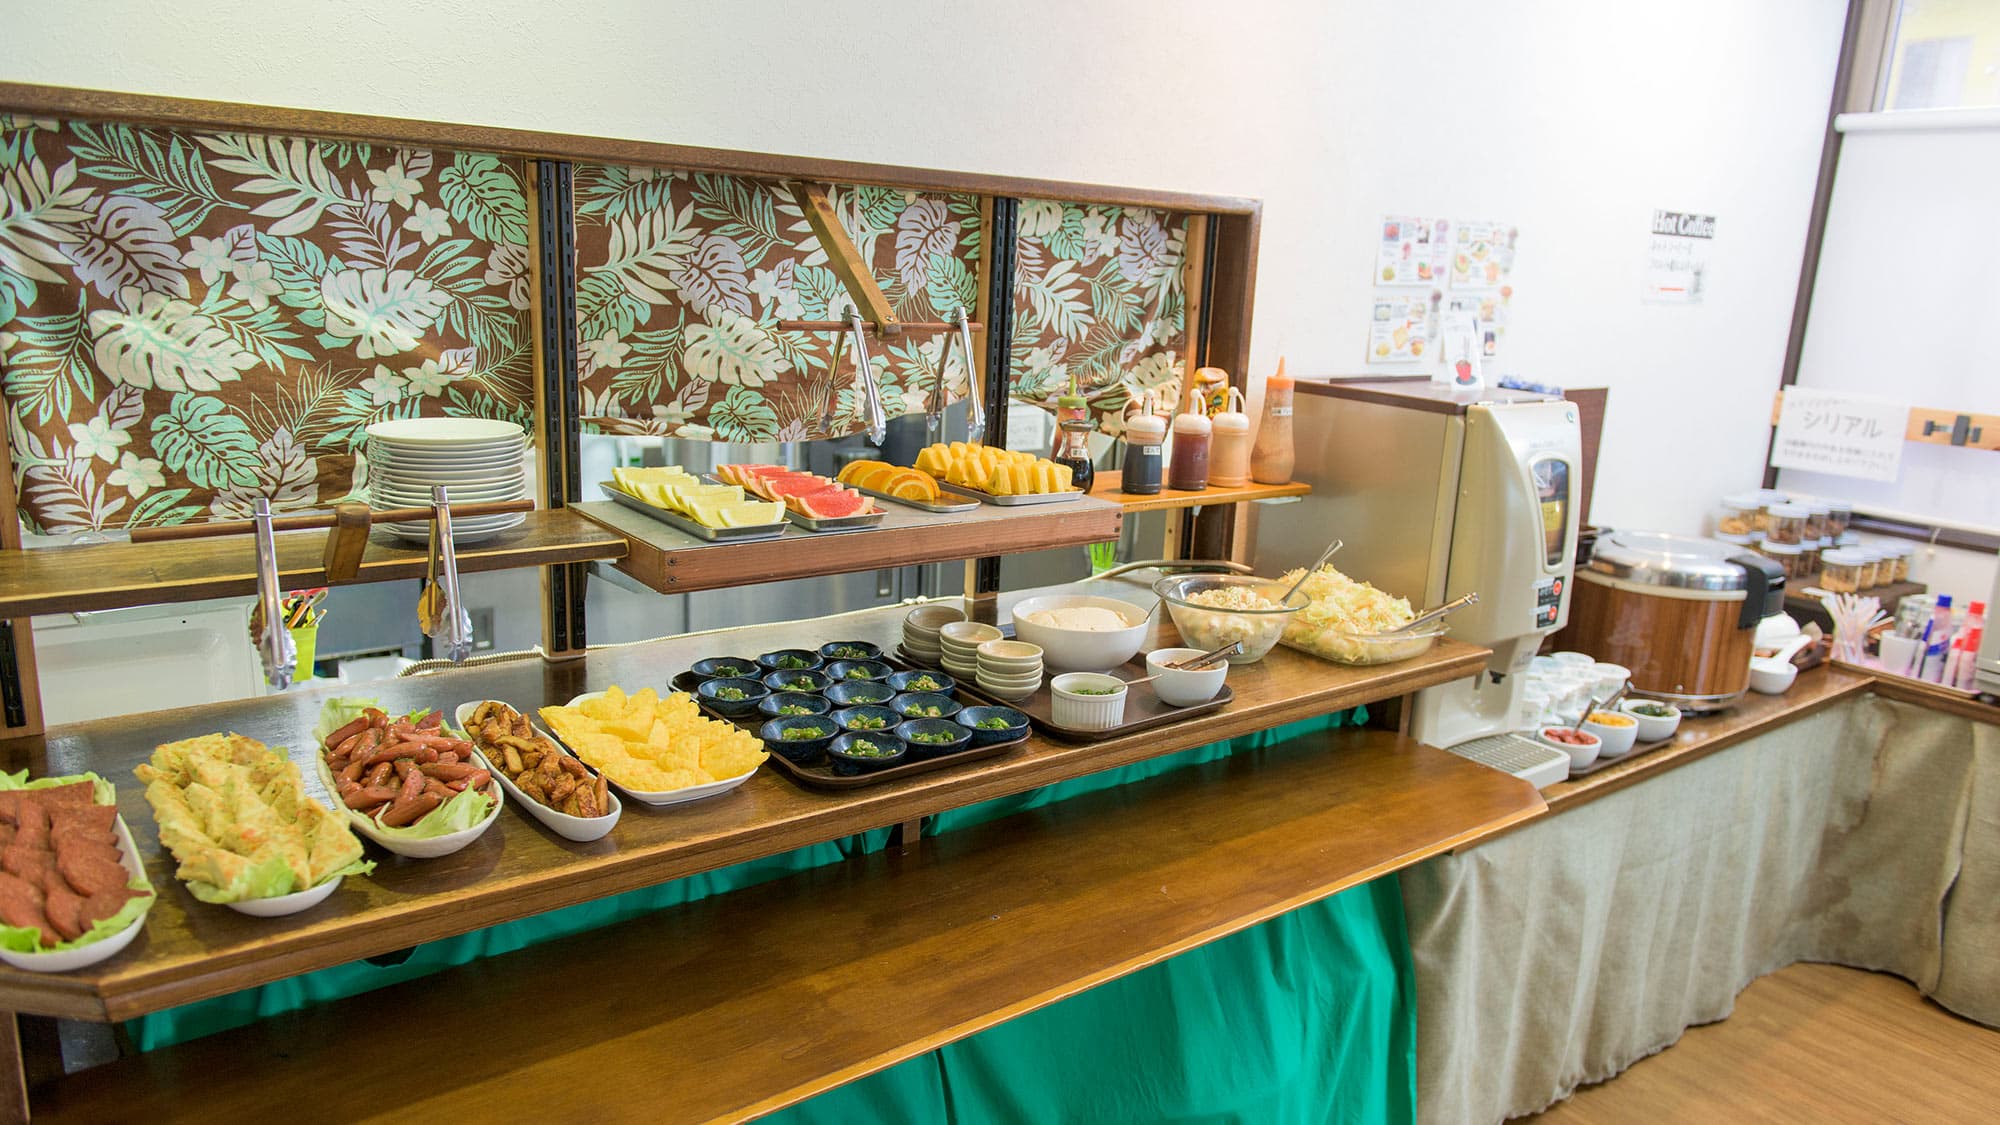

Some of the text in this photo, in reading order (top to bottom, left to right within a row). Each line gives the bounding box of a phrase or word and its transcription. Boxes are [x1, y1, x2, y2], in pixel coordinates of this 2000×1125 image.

[1653, 210, 1715, 238] Hot Coffee
[1803, 411, 1883, 438] シリアル
